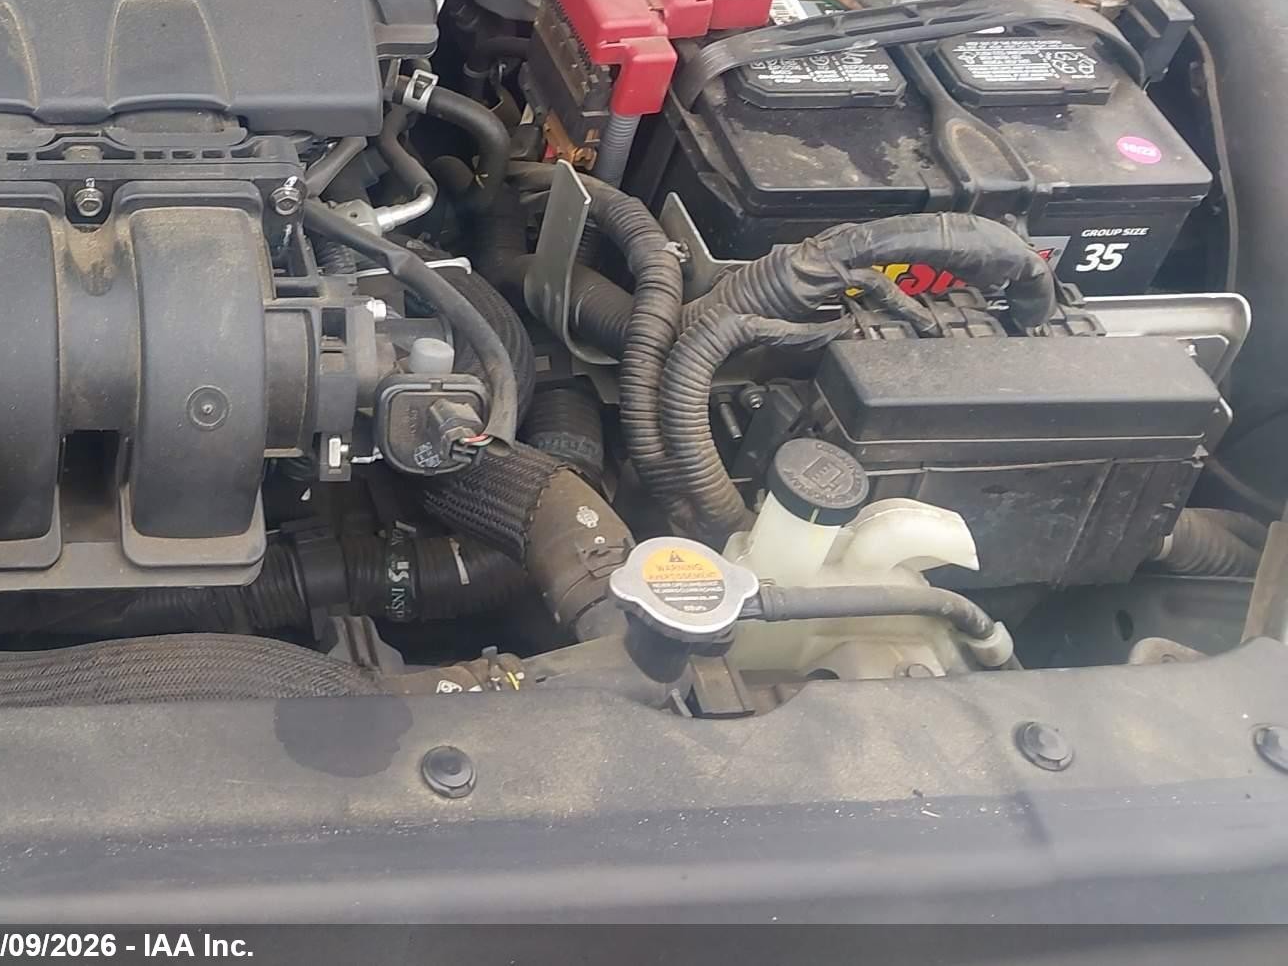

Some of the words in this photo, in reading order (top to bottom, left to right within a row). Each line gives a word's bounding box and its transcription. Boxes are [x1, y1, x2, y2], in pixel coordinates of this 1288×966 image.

[1081, 229, 1122, 238] GROUP
[1121, 227, 1150, 237] SIZE
[1075, 242, 1130, 272] 35
[655, 563, 704, 572] WARNING
